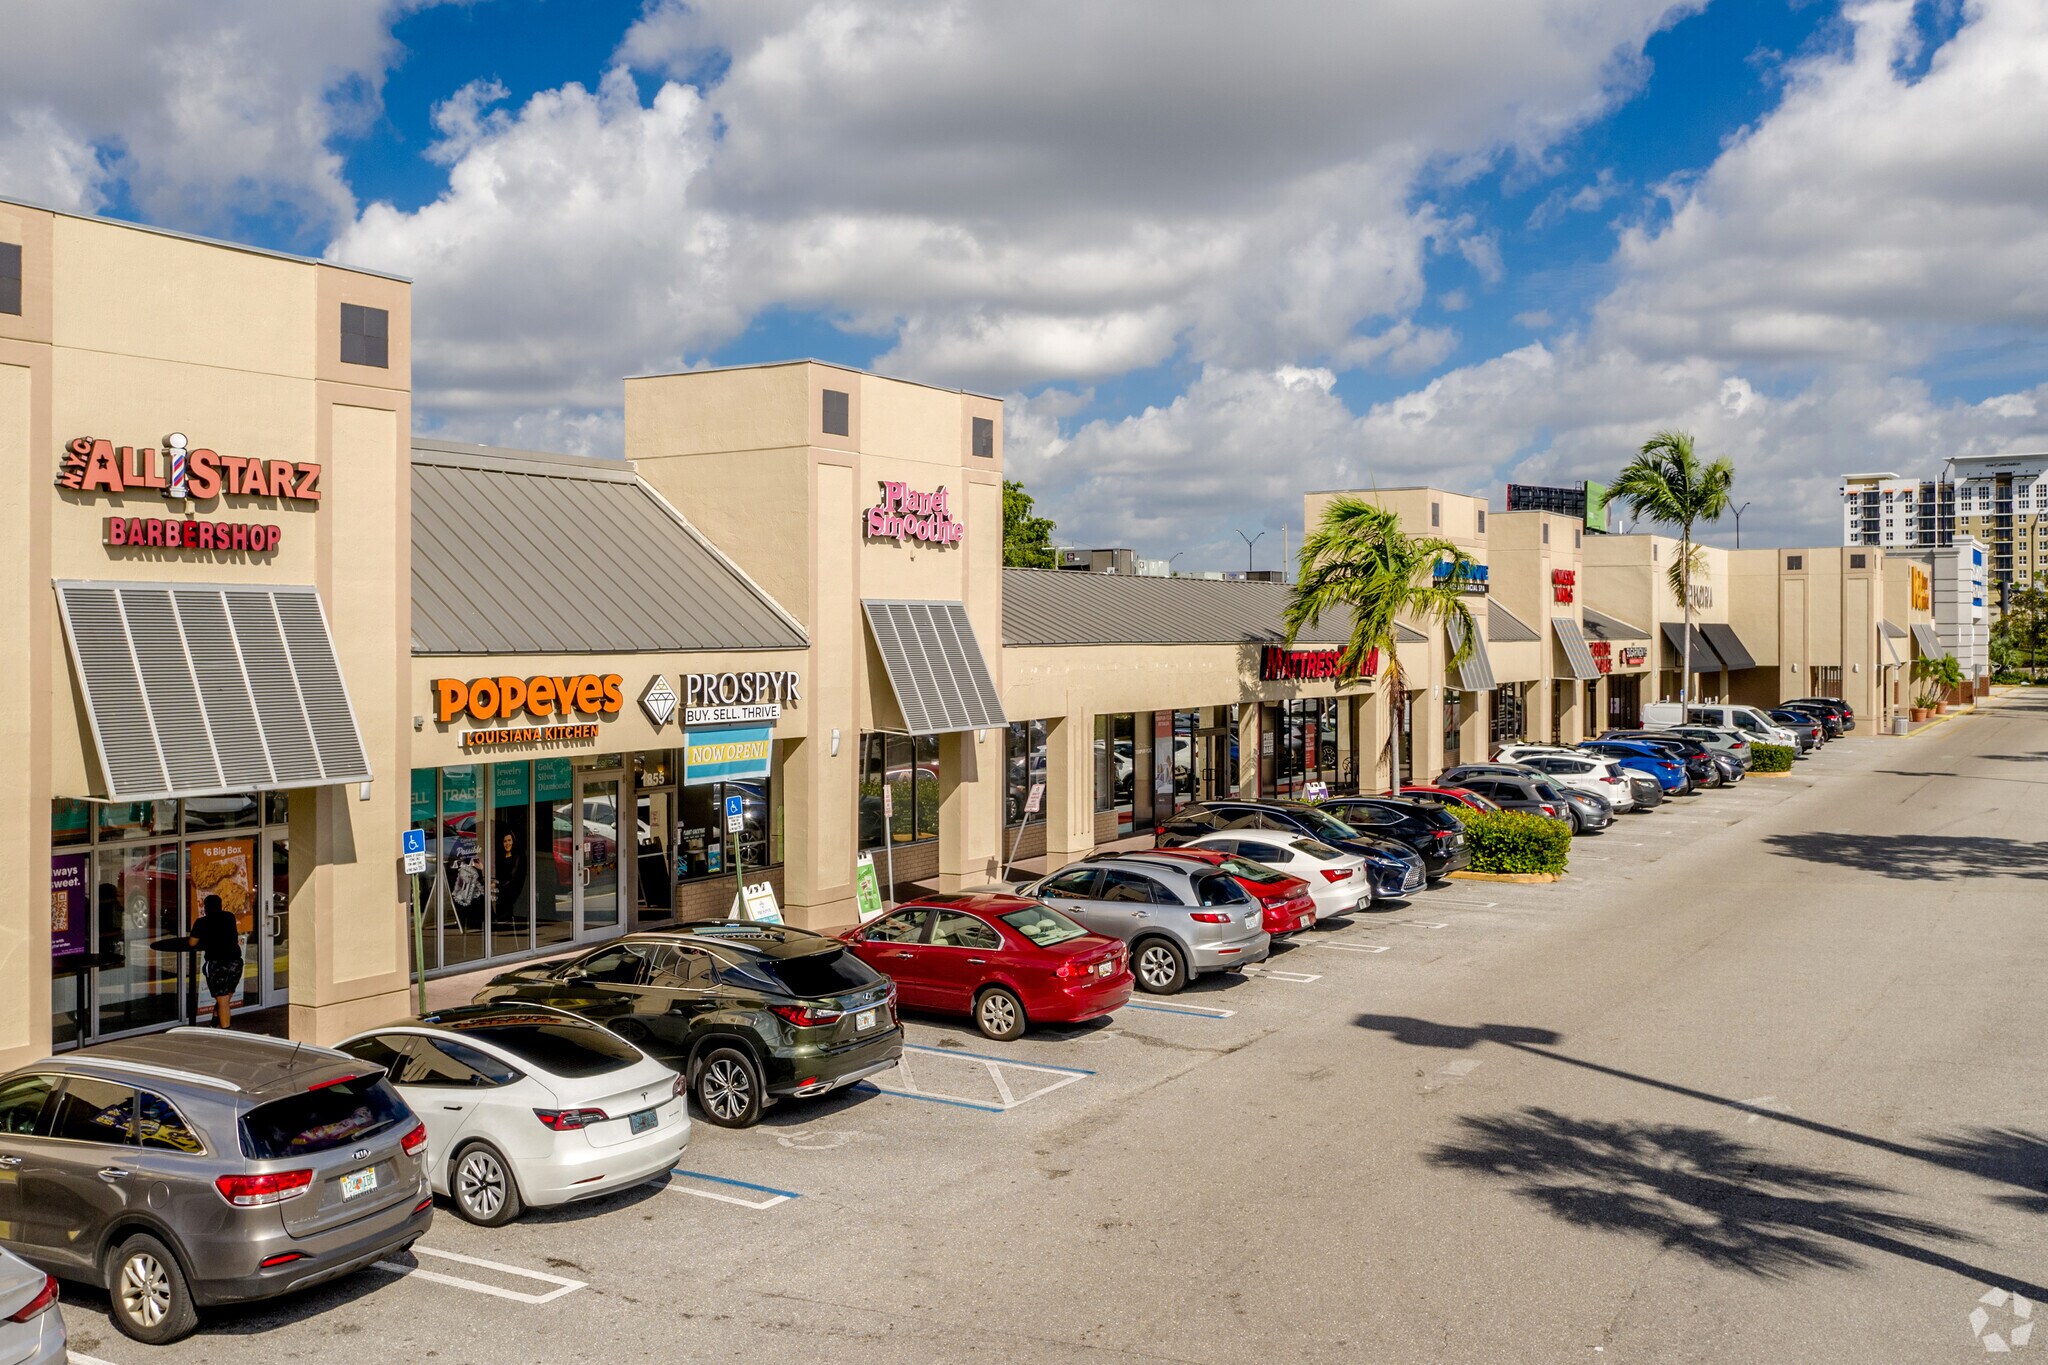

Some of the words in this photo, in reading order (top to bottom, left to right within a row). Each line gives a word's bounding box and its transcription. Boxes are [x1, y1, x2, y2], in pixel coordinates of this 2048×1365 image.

[81, 439, 166, 492] ALL
[188, 448, 321, 500] STARZ
[884, 481, 949, 515] Planet
[868, 503, 964, 545] Smoothie
[110, 517, 281, 551] BARBERSHOP
[1265, 647, 1341, 680] MATTRESS
[687, 671, 801, 705] PROSPYR
[687, 710, 711, 722] BUY.
[714, 708, 740, 720] SELL.
[742, 706, 780, 719] THRIVE.
[467, 727, 541, 746] LOUISIANA
[545, 724, 599, 741] KITCHEN
[692, 745, 725, 763] NOW
[727, 742, 764, 760] OPEN!
[497, 767, 521, 776] Jewelry
[537, 762, 554, 771] Gold
[497, 778, 516, 787] Coins
[537, 772, 557, 781] Silver
[641, 772, 665, 786] 1855
[497, 788, 522, 797] Bullion
[537, 780, 571, 792] Diamonds
[411, 791, 430, 805] ELL
[443, 787, 484, 801] TRADE
[203, 848, 212, 856] $6
[213, 848, 226, 856] Big
[227, 846, 242, 855] Box
[456, 845, 482, 857] Possible
[51, 866, 78, 878] lways
[355, 1150, 368, 1159] KIA
